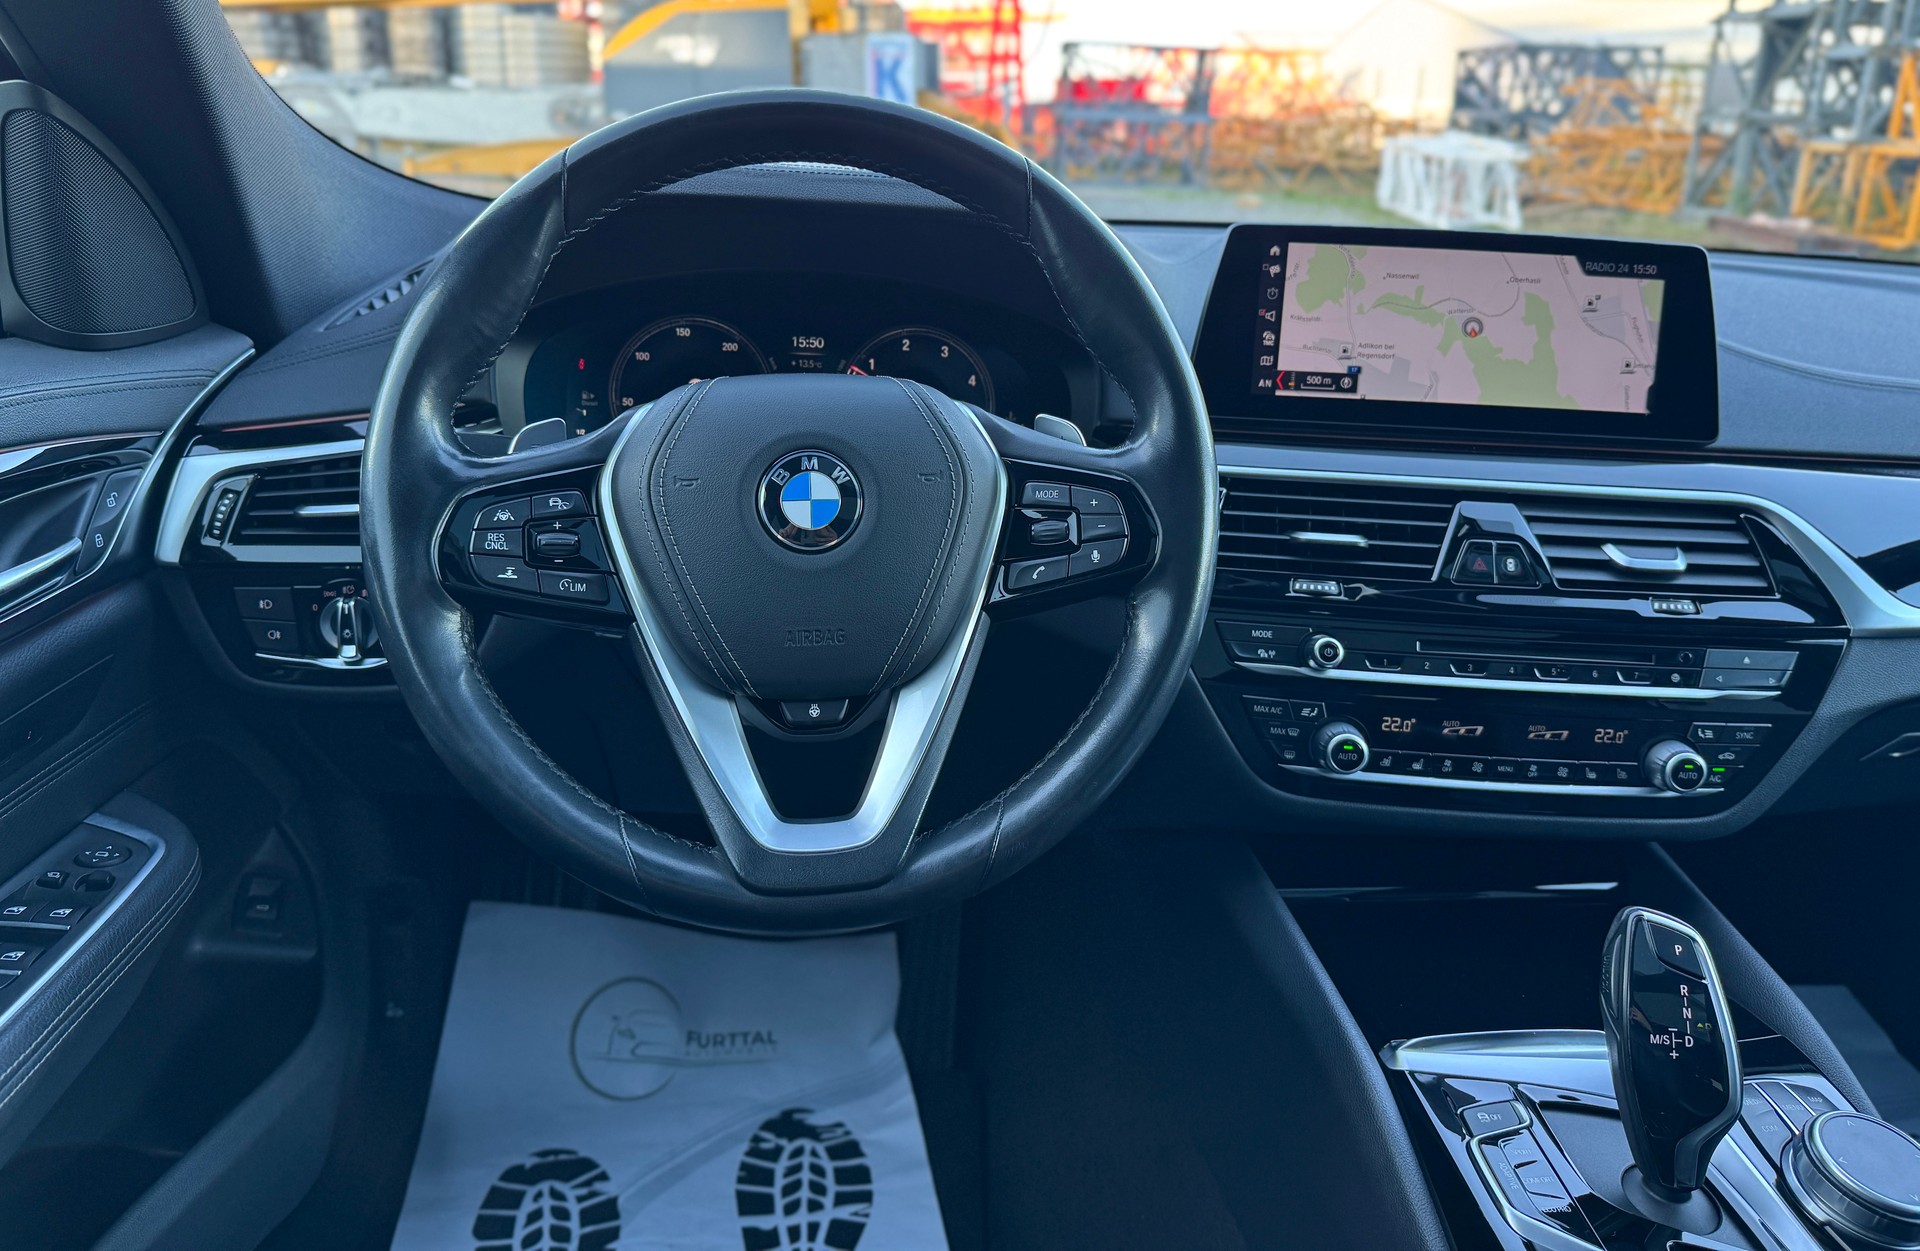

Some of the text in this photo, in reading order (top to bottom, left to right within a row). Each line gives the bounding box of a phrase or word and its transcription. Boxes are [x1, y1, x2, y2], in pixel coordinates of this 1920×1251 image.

[875, 55, 908, 102] K
[1585, 262, 1657, 275] RADIO 24 15:50
[1386, 272, 1419, 280] Nassenwil
[1509, 276, 1541, 285] Oberhasli
[675, 328, 691, 337] 150
[722, 342, 738, 351] 200
[792, 336, 825, 348] 15:50
[902, 339, 910, 351] 2
[1358, 342, 1382, 350] Adlikon
[635, 352, 650, 361] 100
[941, 346, 949, 358] 3
[1357, 352, 1395, 360] Regensdorf
[869, 358, 875, 370] 1
[968, 375, 977, 387] 4
[1258, 379, 1272, 388] AN
[1306, 376, 1322, 385] 500
[622, 398, 634, 406] 50
[771, 456, 852, 485] BMW
[1035, 490, 1059, 499] MODE
[487, 533, 505, 542] RES
[485, 541, 509, 550] CNCL
[570, 583, 587, 592] LIM
[784, 630, 846, 647] AIRBAG
[1251, 630, 1273, 639] MODE
[1424, 662, 1430, 670] 2
[1508, 666, 1514, 674] 4
[1253, 705, 1283, 715] MAX A/C
[1270, 727, 1286, 735] MAX
[1338, 752, 1358, 760] AUTO
[1678, 771, 1698, 779] AUTO
[1709, 774, 1721, 783] A/C
[1674, 944, 1683, 956] P
[1680, 984, 1689, 997] R
[1682, 1007, 1692, 1019] N
[685, 1030, 778, 1049] FURTTAL
[1649, 1034, 1670, 1045] M/S
[1684, 1035, 1694, 1048] D
